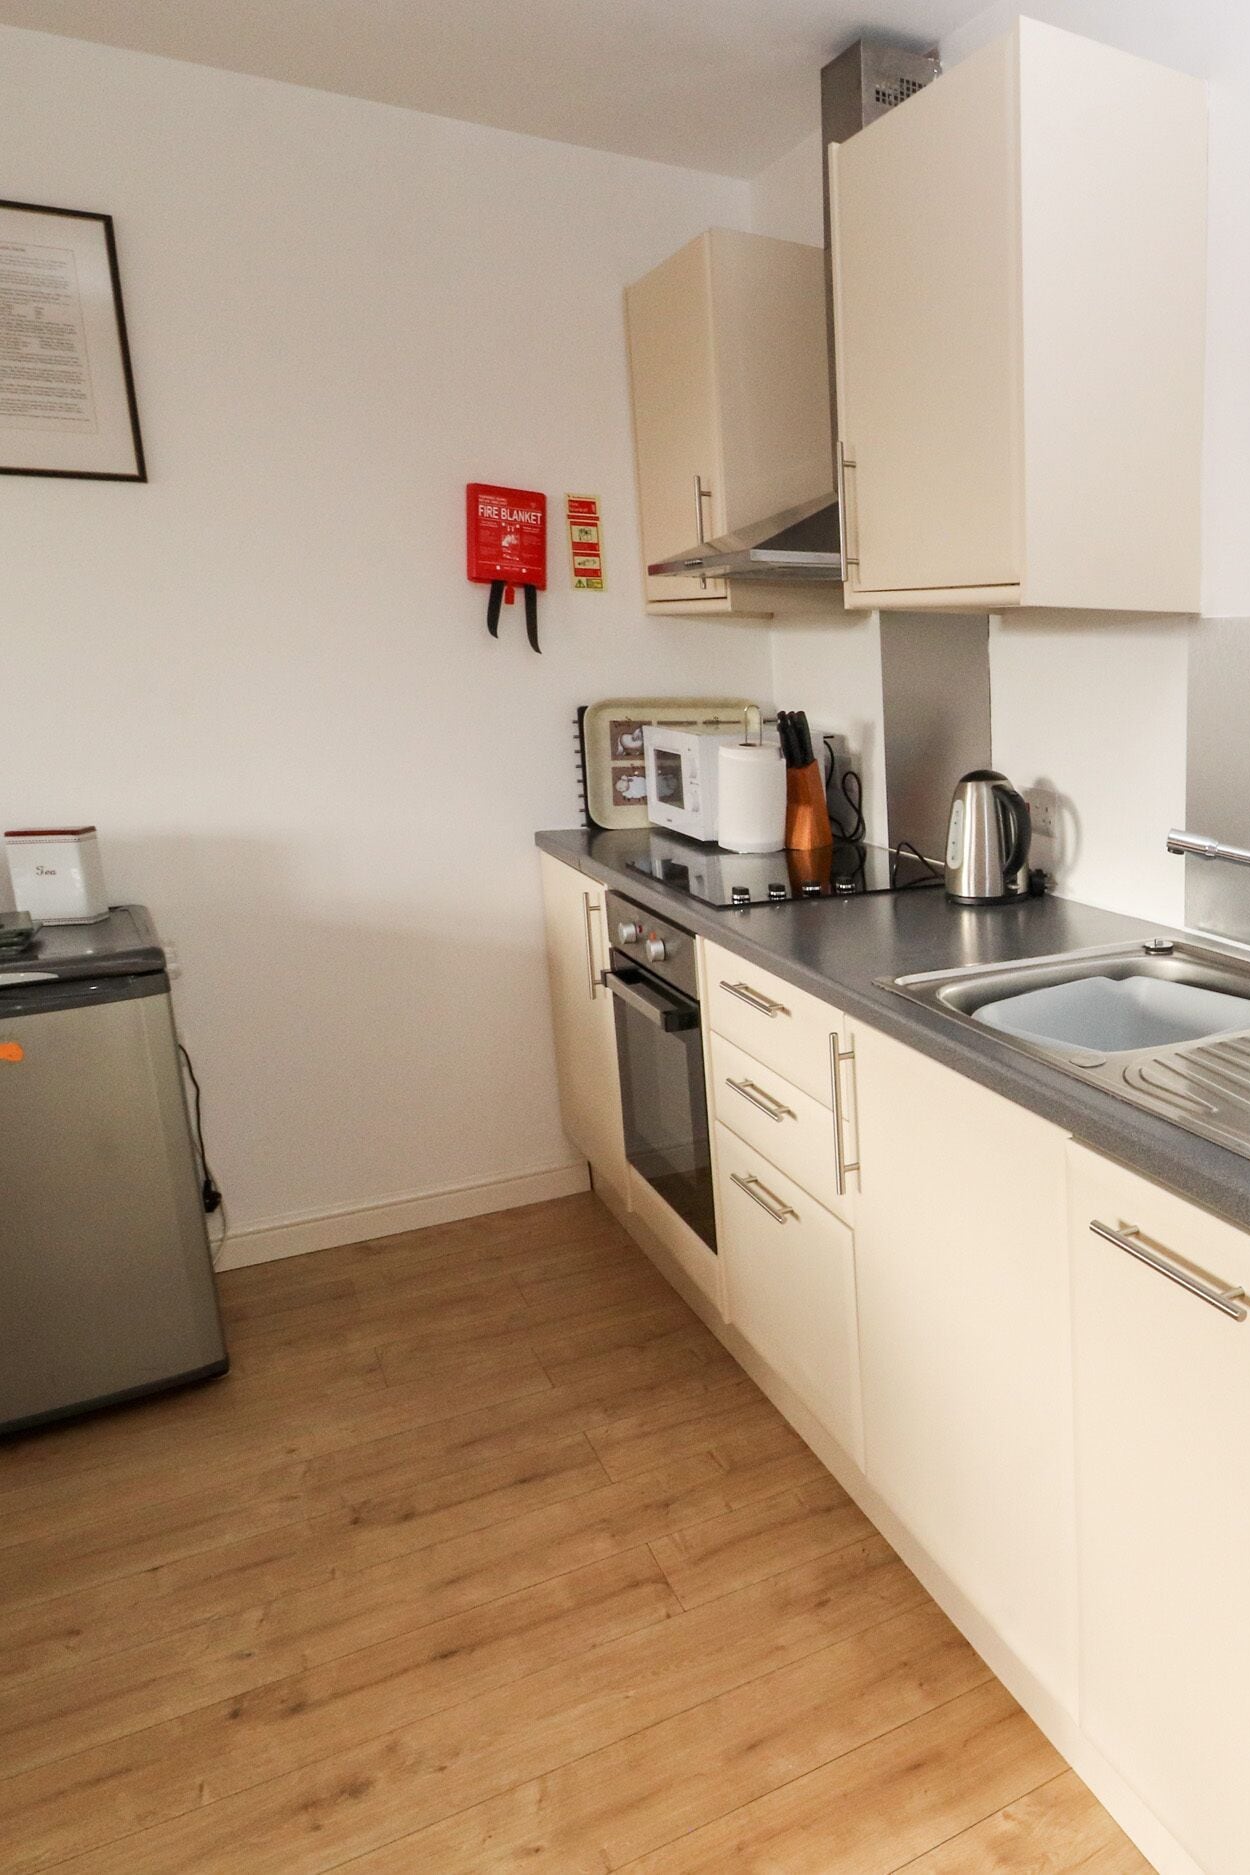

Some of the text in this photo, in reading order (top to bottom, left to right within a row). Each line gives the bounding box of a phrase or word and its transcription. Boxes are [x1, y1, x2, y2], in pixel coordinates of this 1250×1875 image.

[478, 505, 542, 524] FIRE BLANKET
[35, 865, 57, 877] Tea
